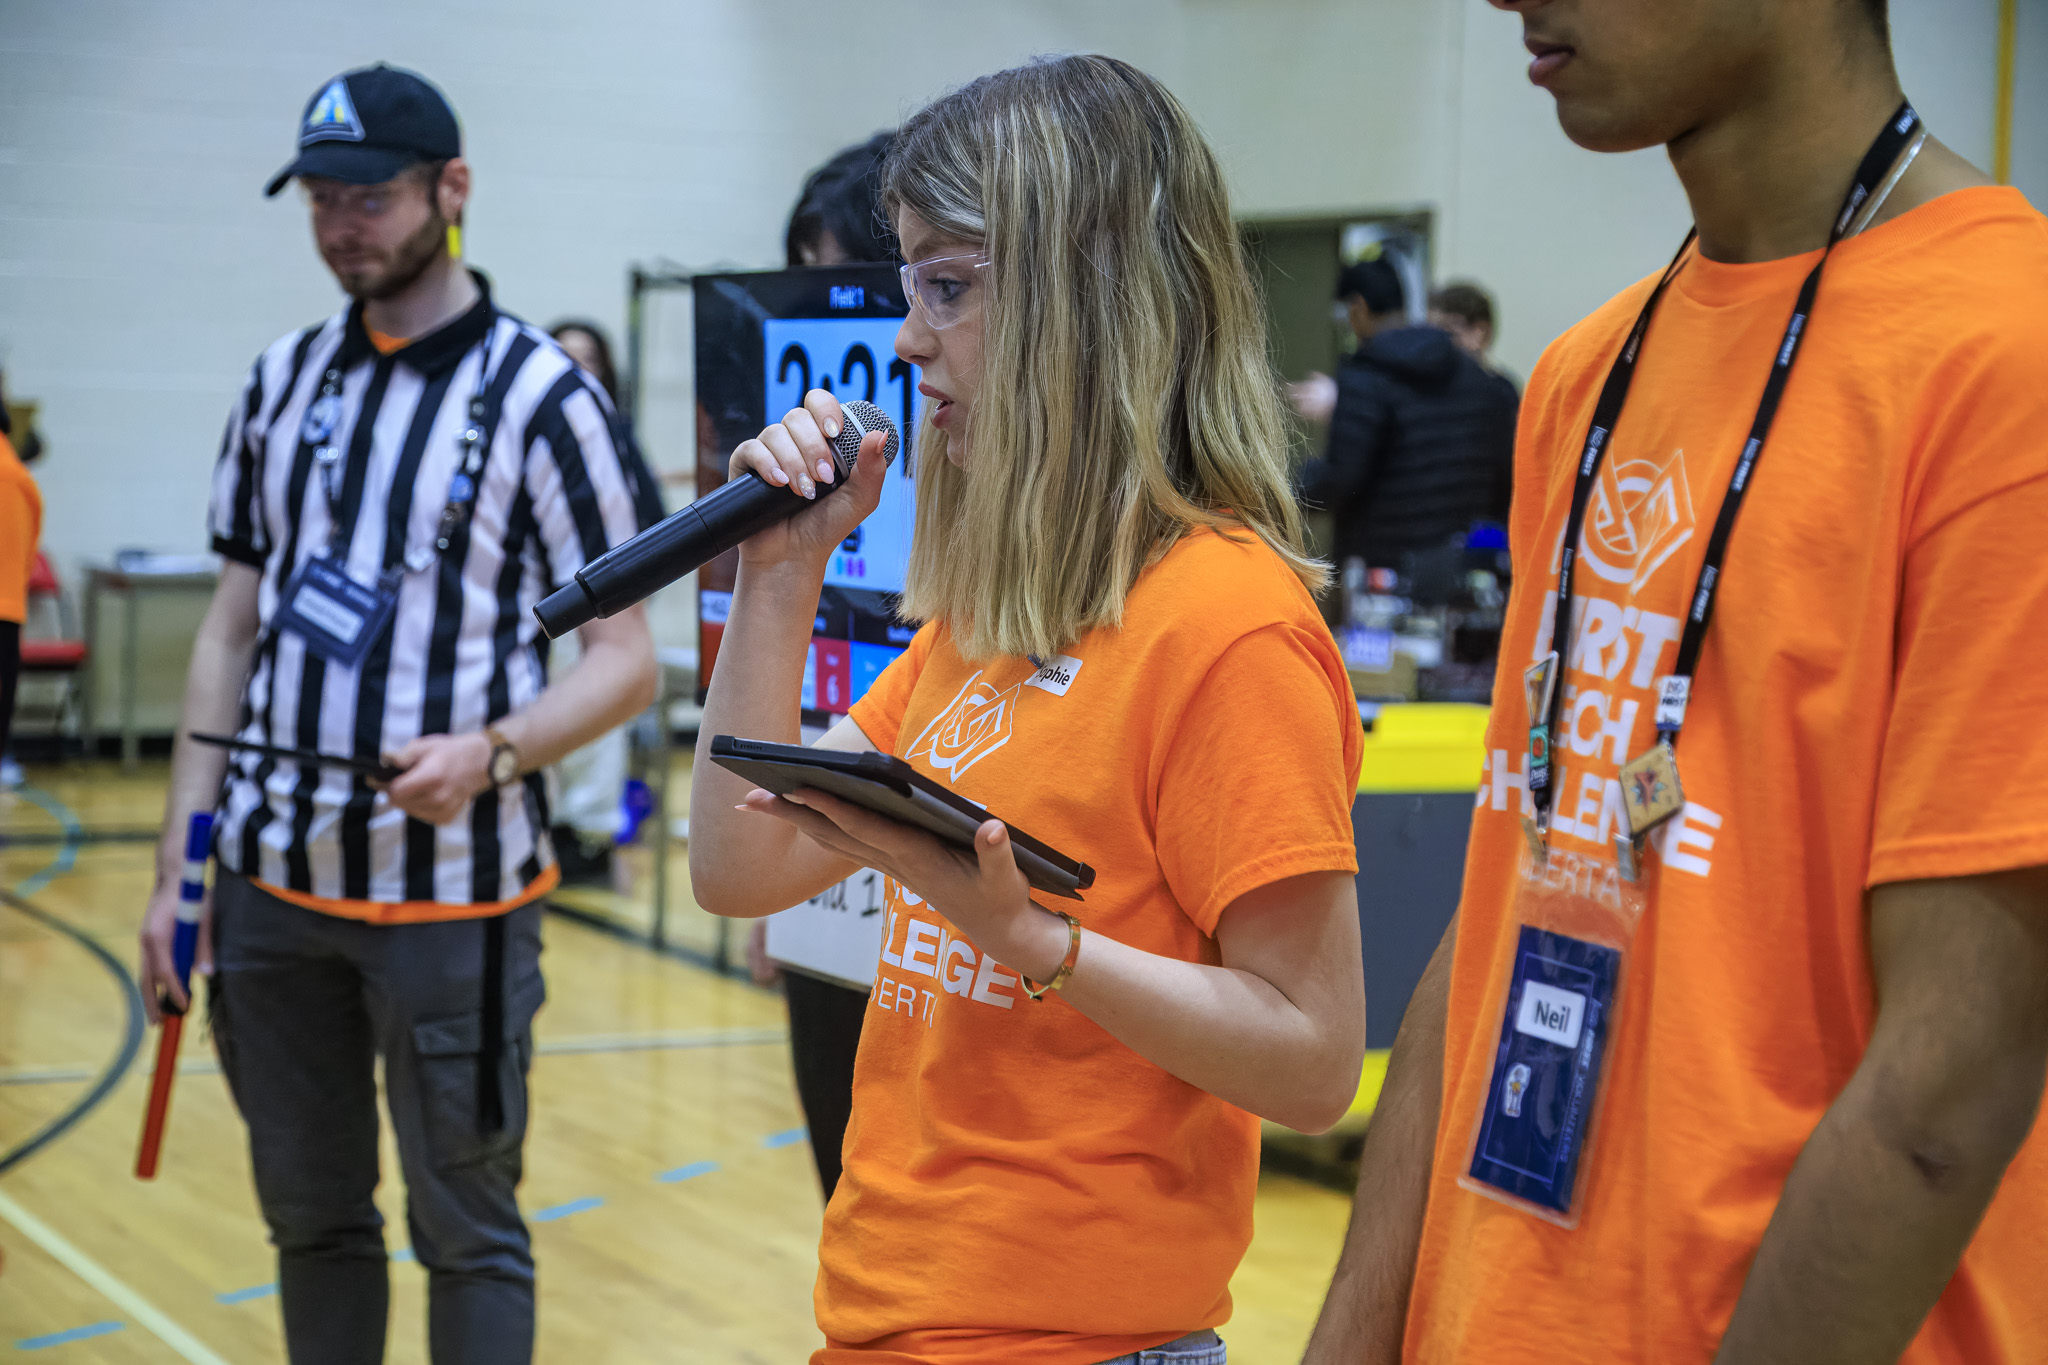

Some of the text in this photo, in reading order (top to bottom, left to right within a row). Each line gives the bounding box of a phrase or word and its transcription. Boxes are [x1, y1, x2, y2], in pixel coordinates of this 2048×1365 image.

[1582, 447, 1598, 477] FIRST
[1036, 665, 1070, 686] ophie
[1557, 684, 1640, 766] ECH
[1534, 999, 1571, 1033] Neil
